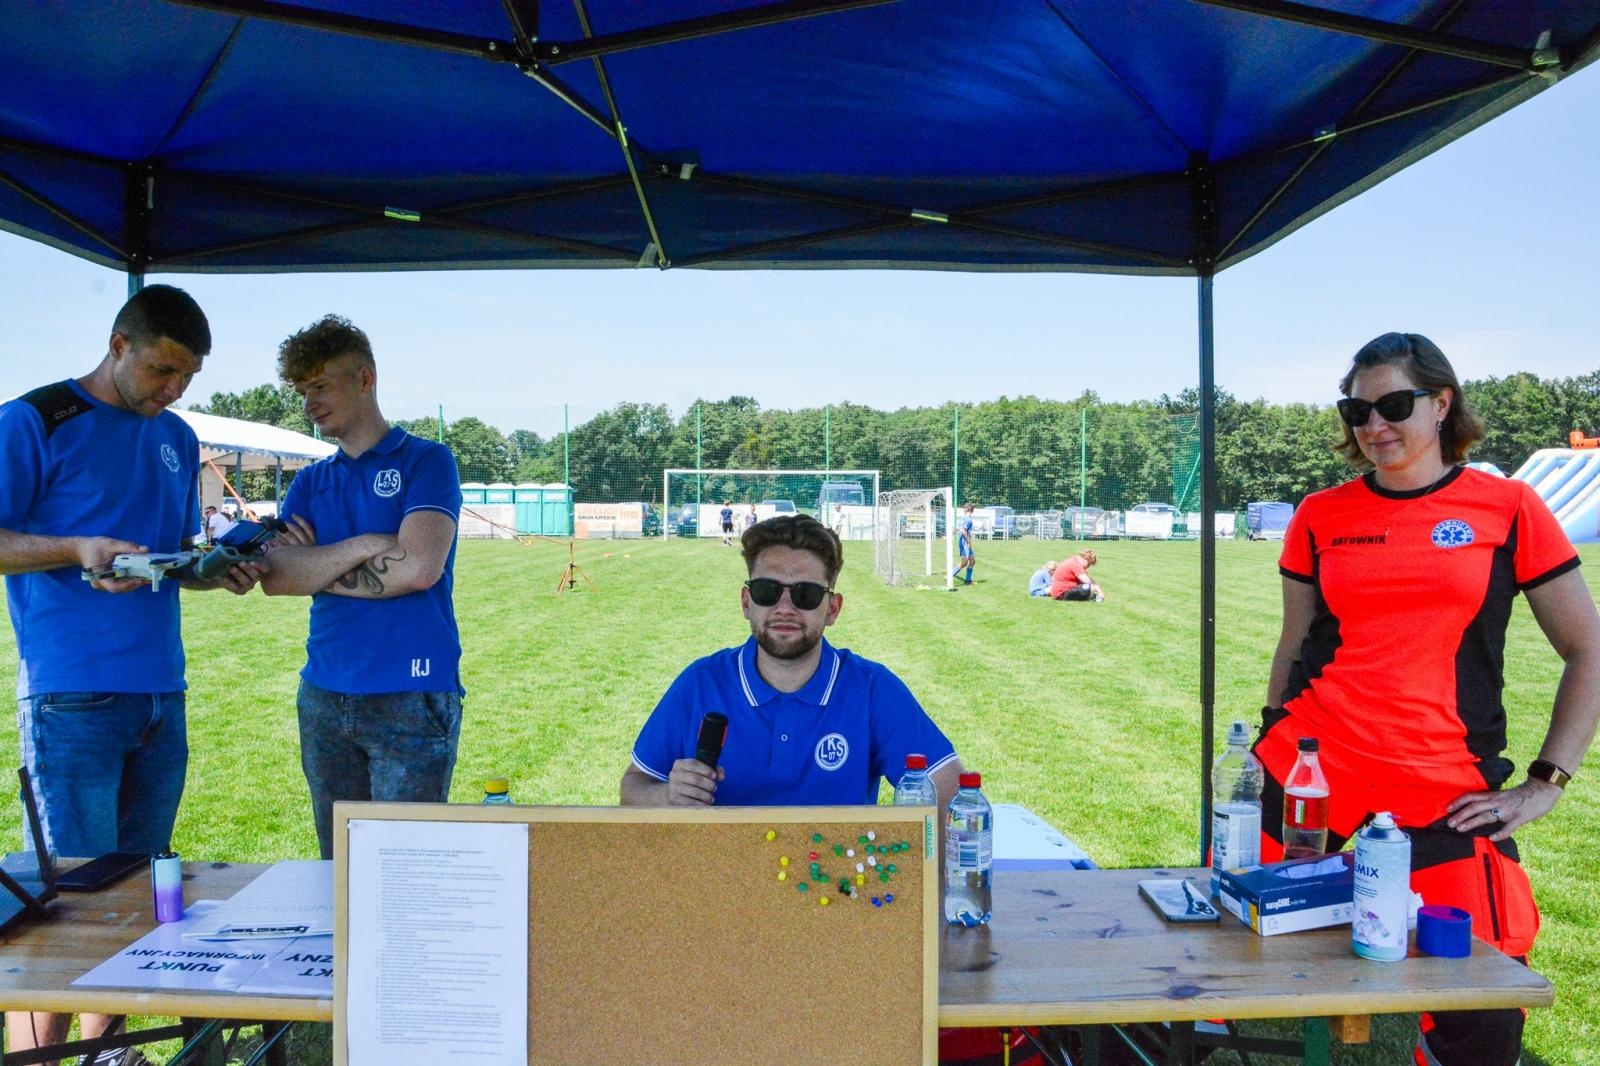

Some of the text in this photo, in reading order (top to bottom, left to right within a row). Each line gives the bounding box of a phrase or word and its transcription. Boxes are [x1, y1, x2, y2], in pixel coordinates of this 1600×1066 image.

[411, 658, 430, 677] KJ
[820, 737, 844, 758] LKS
[126, 949, 266, 960] INFORMACYJNY
[137, 961, 225, 972] PUNKT
[298, 967, 334, 977] KT
